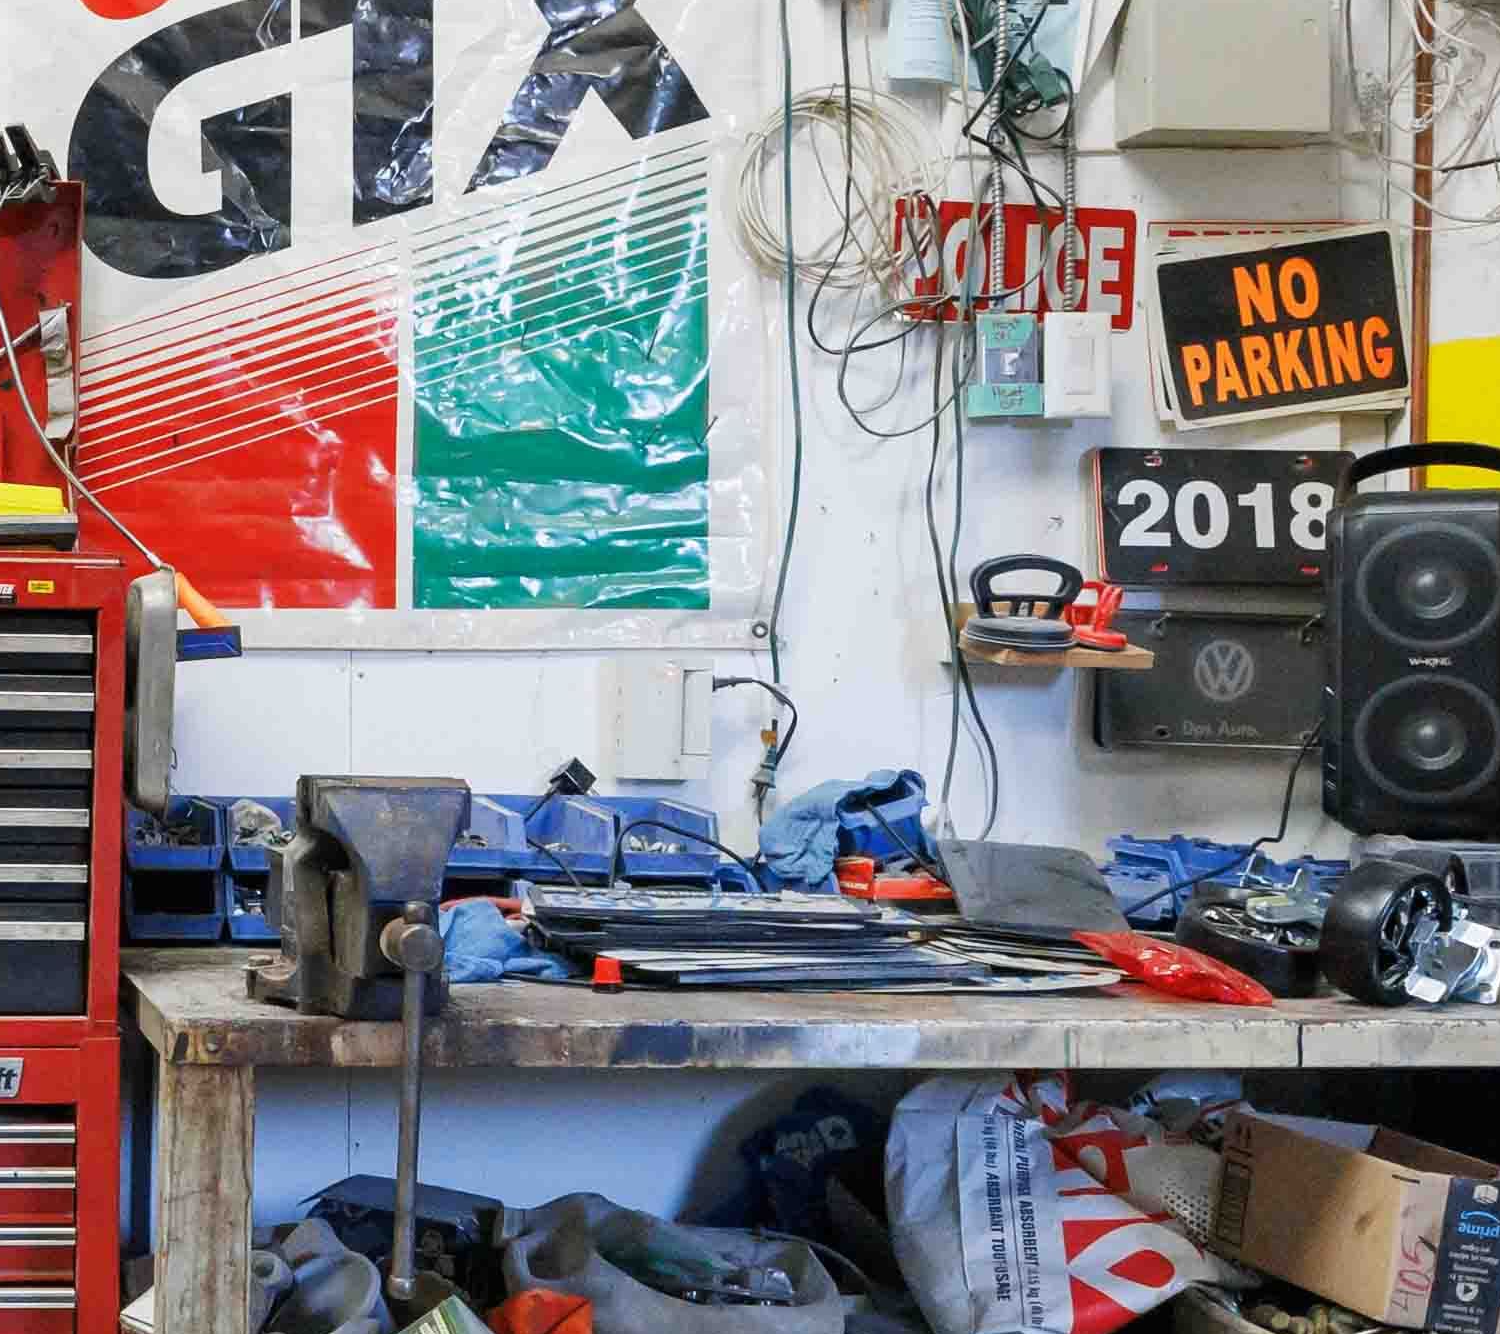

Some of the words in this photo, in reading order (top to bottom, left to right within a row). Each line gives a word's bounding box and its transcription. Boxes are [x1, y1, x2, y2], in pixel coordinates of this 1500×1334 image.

[1232, 256, 1320, 328] NO
[1181, 316, 1395, 407] PARKING
[1118, 479, 1330, 550] 2018
